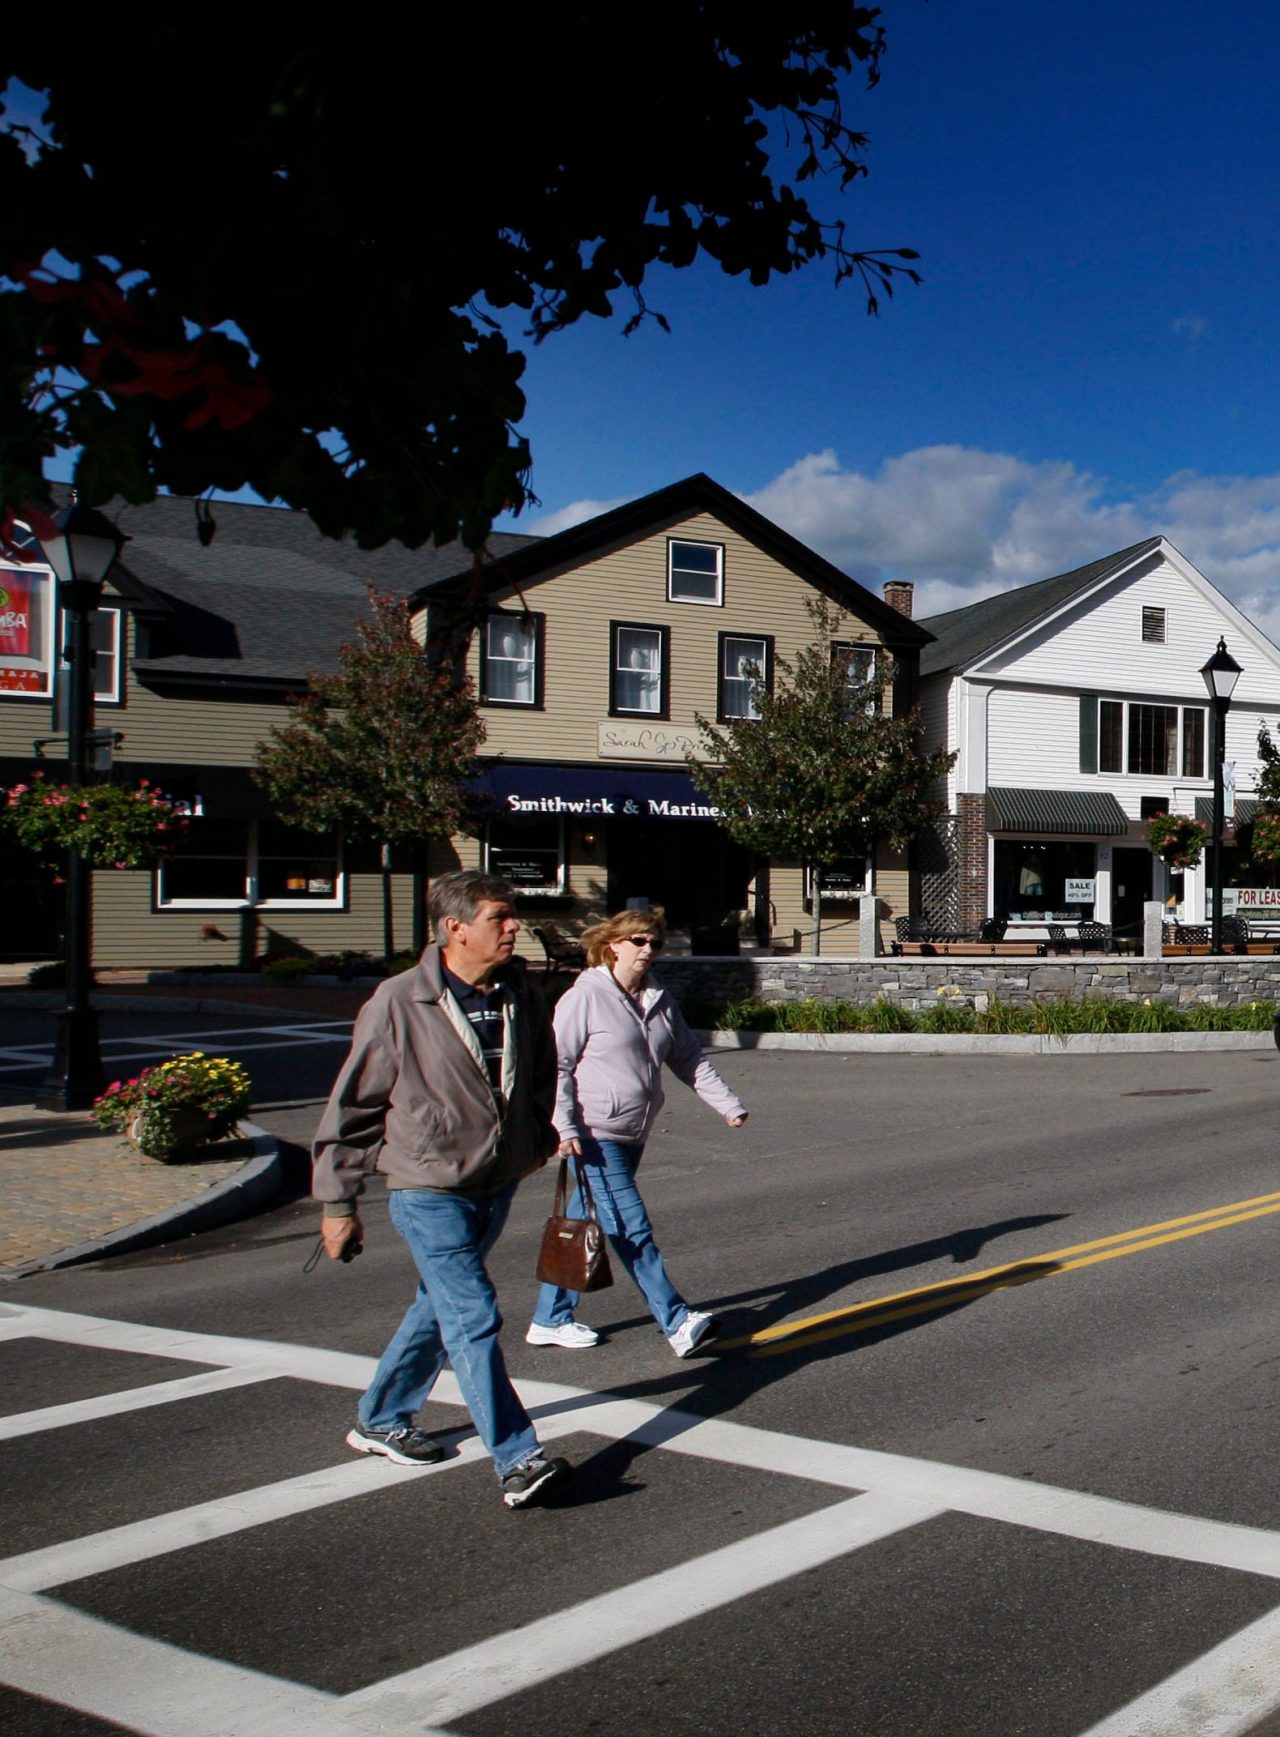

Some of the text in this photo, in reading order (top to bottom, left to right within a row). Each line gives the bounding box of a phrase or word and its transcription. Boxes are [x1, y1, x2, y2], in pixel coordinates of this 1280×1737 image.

[603, 729, 652, 750] Sarah
[507, 794, 615, 815] Smithwick
[623, 799, 640, 816] &
[1069, 882, 1091, 890] SALE
[1237, 890, 1257, 905] FOR
